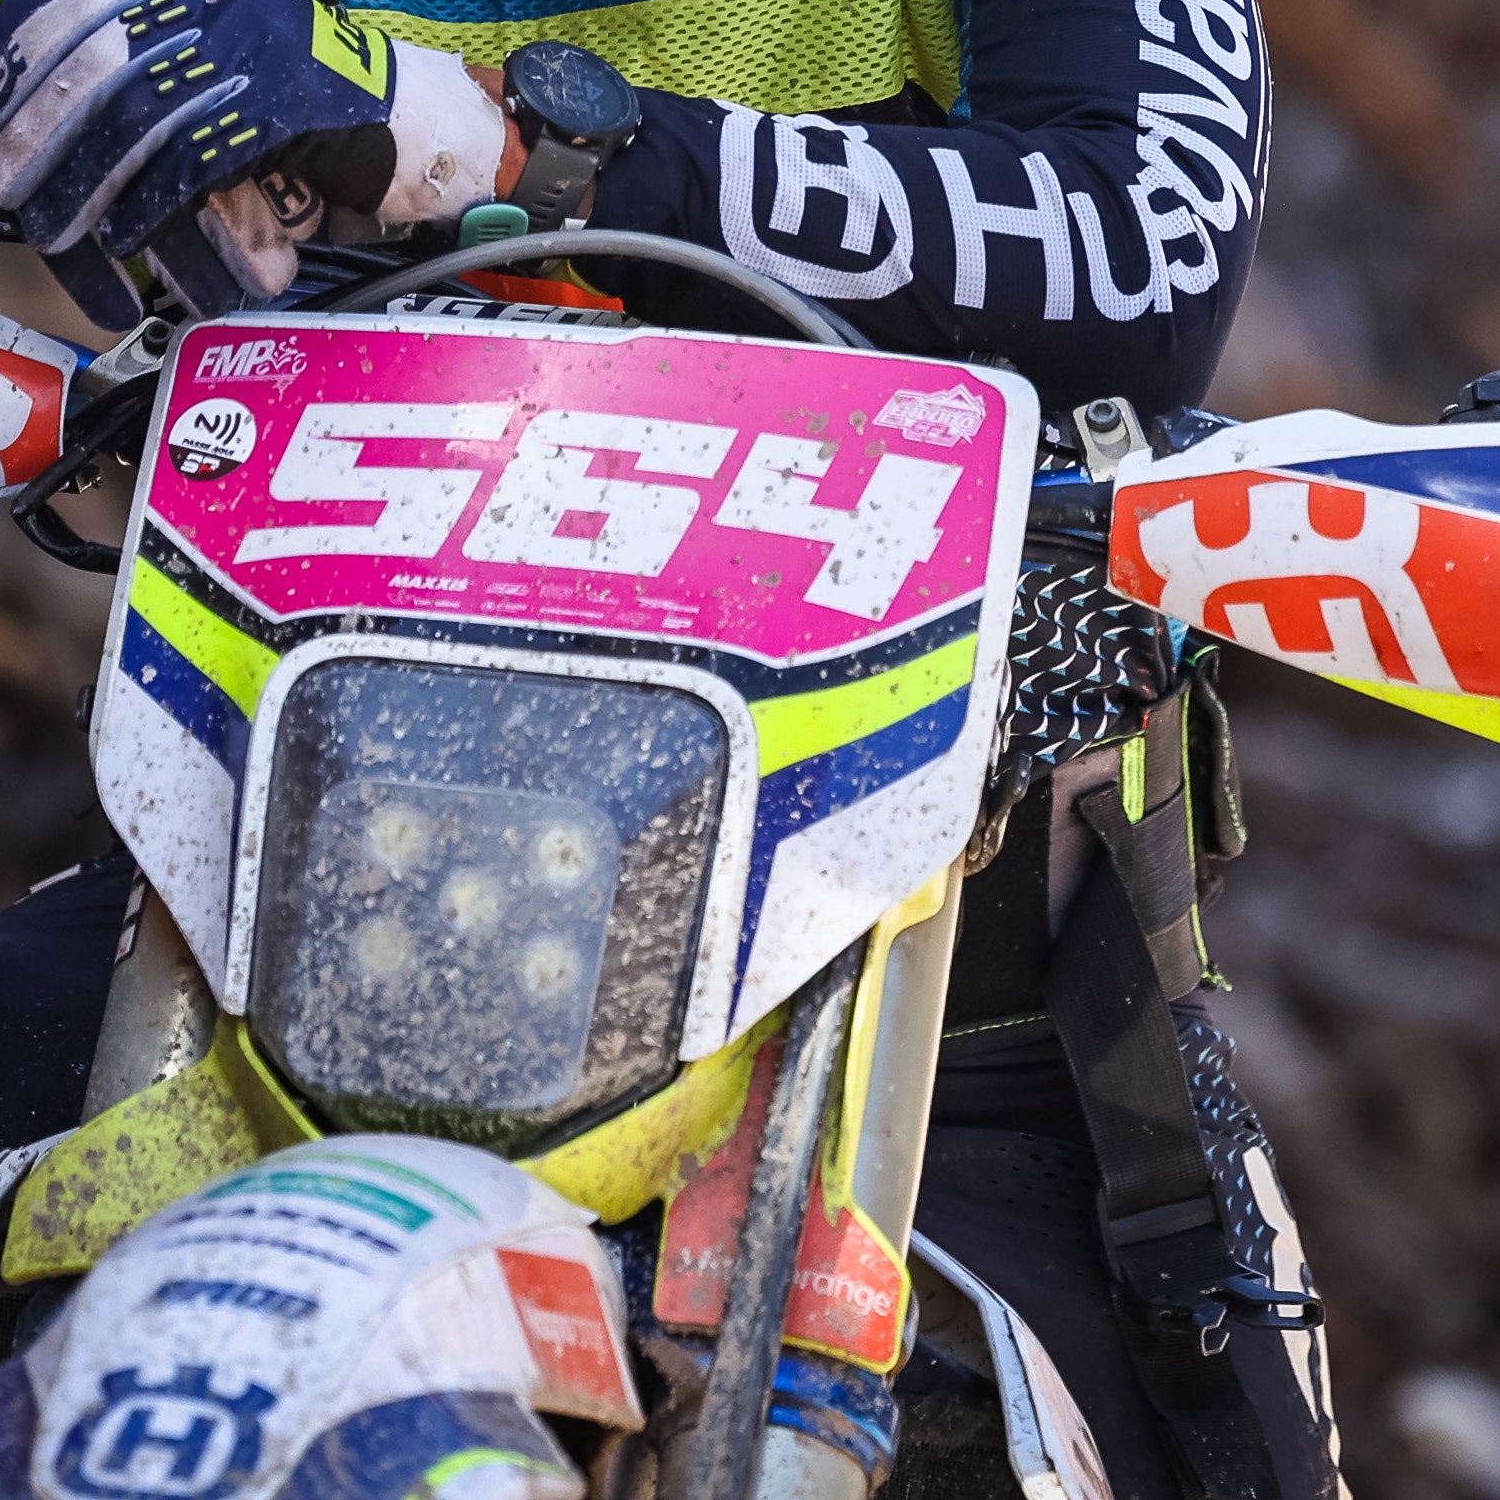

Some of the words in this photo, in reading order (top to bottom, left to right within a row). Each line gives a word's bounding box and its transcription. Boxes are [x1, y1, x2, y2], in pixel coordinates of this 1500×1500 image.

[195, 338, 277, 378] FMP
[233, 402, 964, 622] 564
[387, 574, 470, 592] MAXXIS
